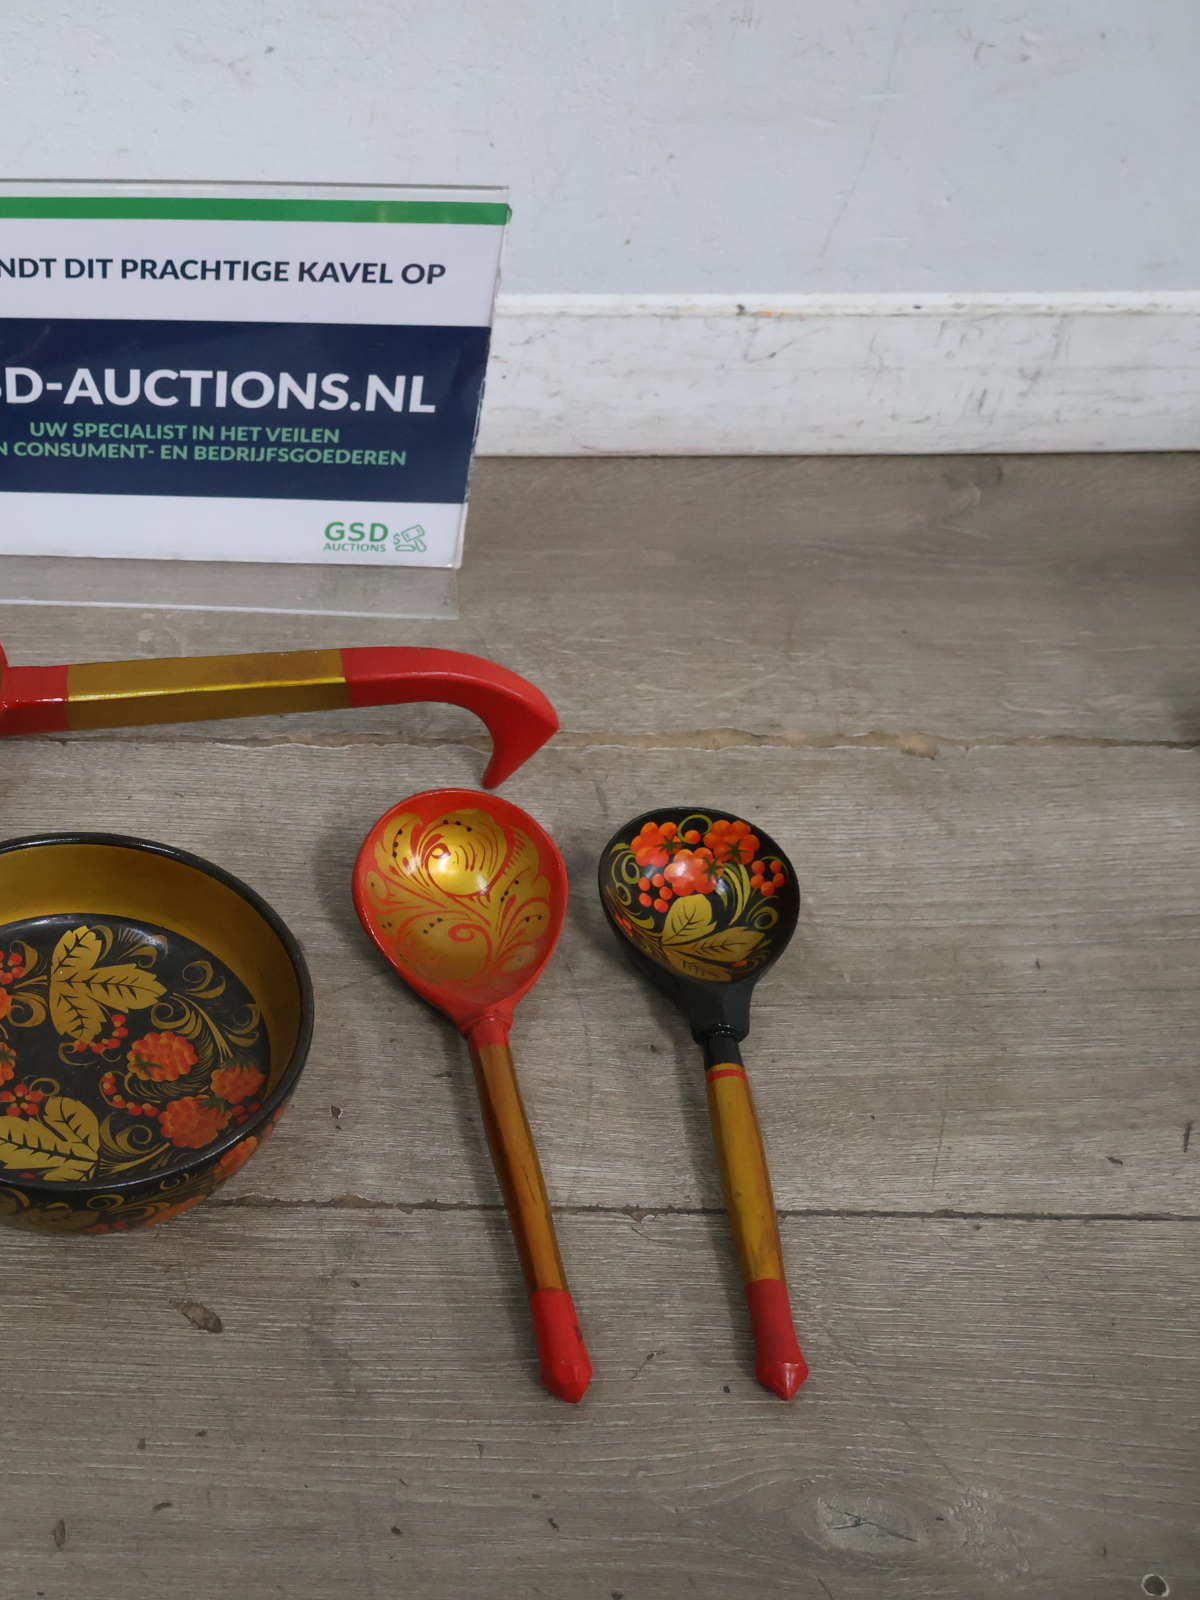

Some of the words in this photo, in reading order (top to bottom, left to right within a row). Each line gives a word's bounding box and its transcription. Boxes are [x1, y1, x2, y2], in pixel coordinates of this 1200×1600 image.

[65, 258, 113, 278] DIT
[121, 259, 289, 280] PRACHTIGE
[298, 261, 393, 282] KAVEL
[400, 263, 445, 283] OP
[30, 421, 67, 436] UW
[73, 422, 186, 440] SPECIALIST
[192, 425, 214, 440] IN
[220, 426, 261, 441] HET
[265, 427, 340, 443] VEILEN
[13, 442, 155, 459] CONSUMENT-
[160, 445, 188, 459] EN
[194, 445, 406, 465] BEDRIJFSGOEDEREN
[324, 522, 389, 542] GSD
[324, 543, 387, 553] AUCTIONS
